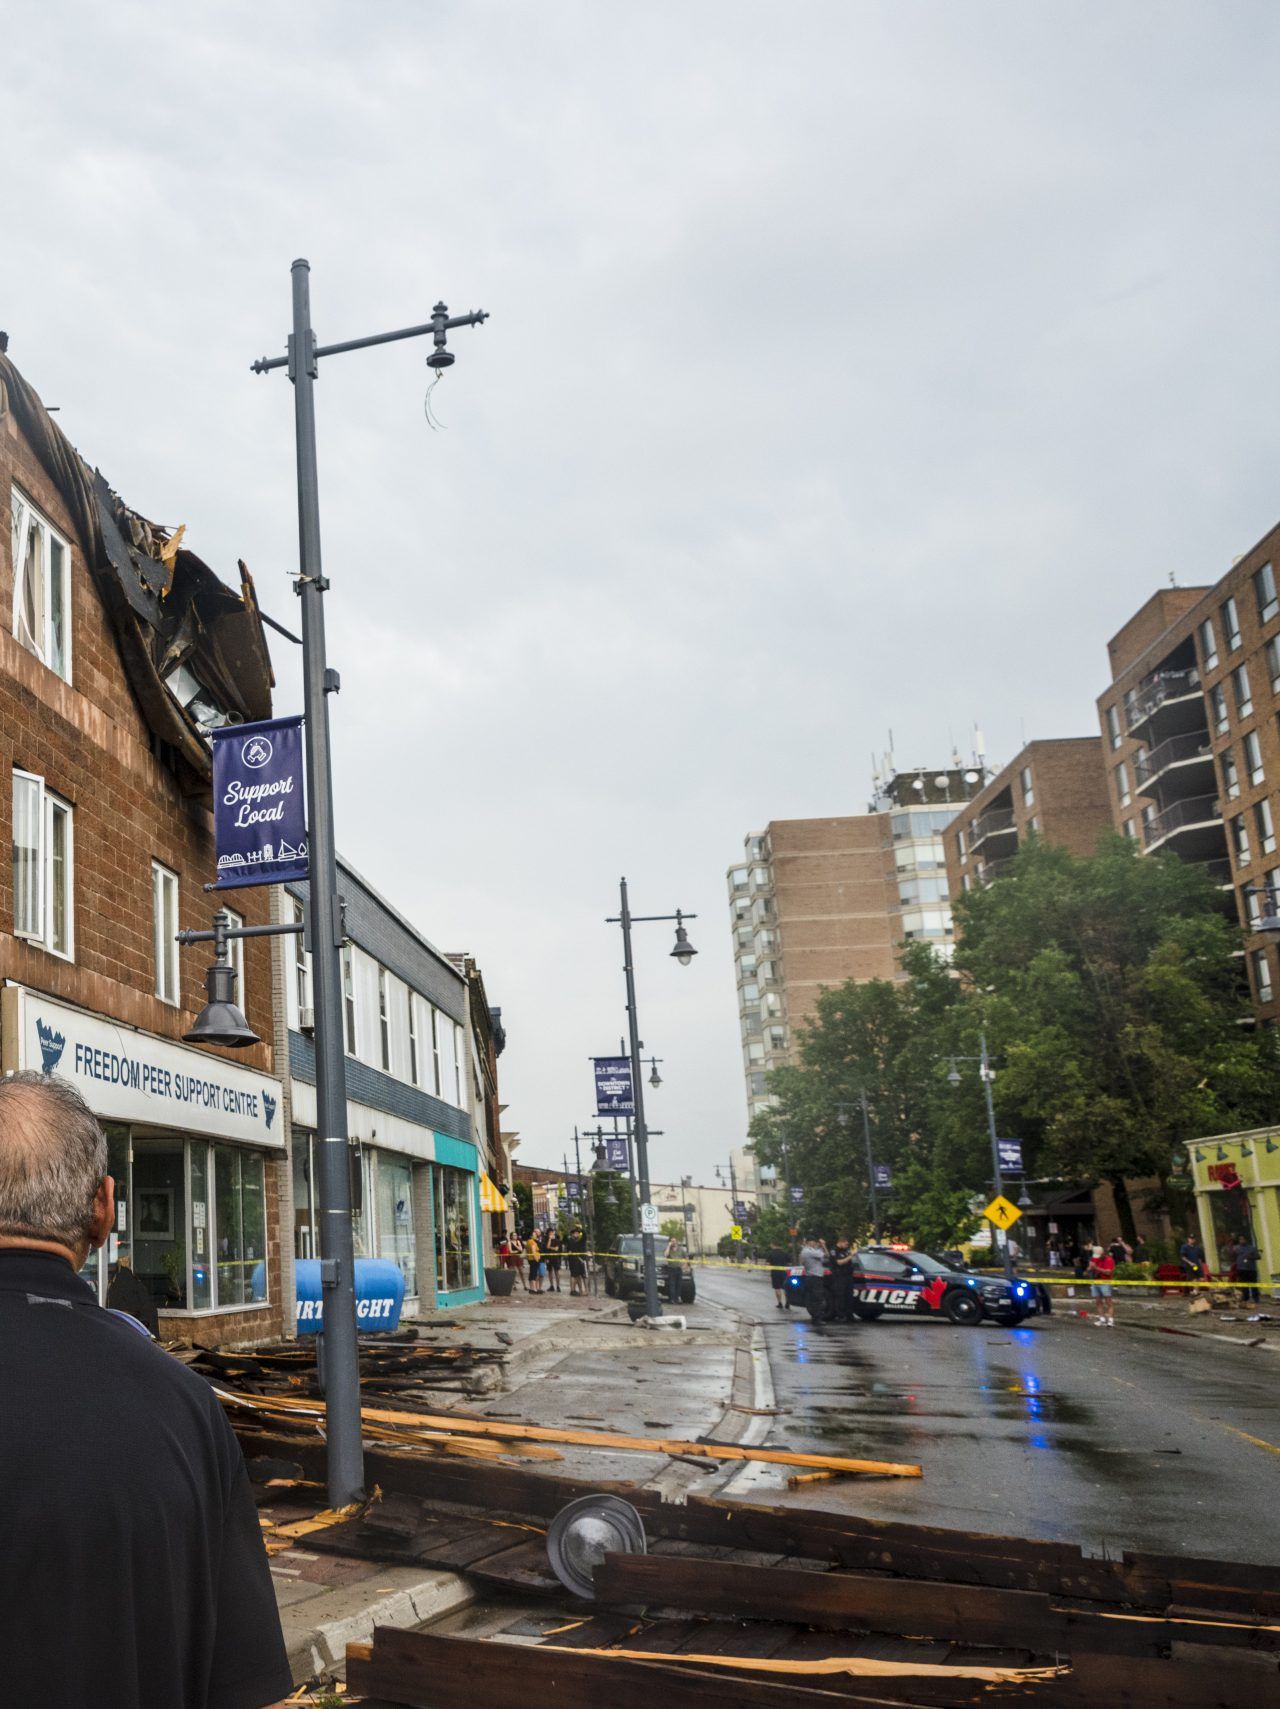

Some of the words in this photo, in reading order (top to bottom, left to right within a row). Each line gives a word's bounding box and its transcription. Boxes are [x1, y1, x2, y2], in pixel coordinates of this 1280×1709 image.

[224, 776, 294, 805] Support
[235, 801, 284, 828] Local
[75, 1043, 140, 1089] FREEDOM
[143, 1064, 172, 1098] PEER
[174, 1073, 221, 1111] SUPPORT
[222, 1087, 258, 1118] CENTRE
